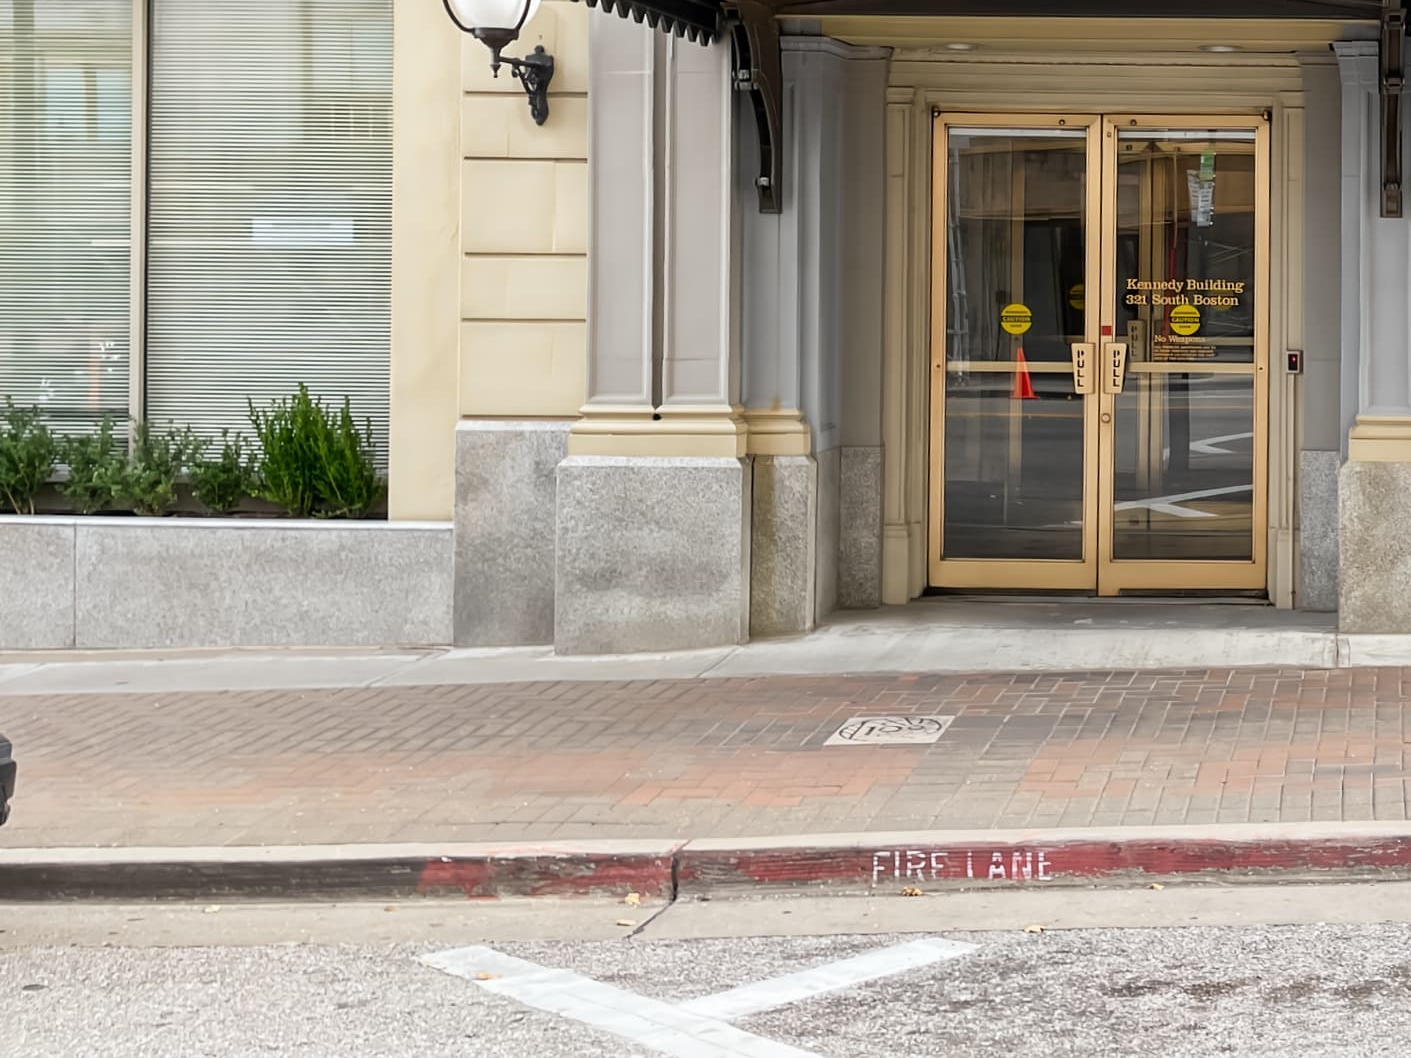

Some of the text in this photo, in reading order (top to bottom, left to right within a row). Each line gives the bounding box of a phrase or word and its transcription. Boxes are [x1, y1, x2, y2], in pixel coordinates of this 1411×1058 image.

[1126, 278, 1245, 293] Kennedy Building
[1126, 294, 1239, 306] 321 South Boston
[1154, 334, 1167, 342] No
[1077, 349, 1085, 387] PULL
[1113, 349, 1121, 387] PULL
